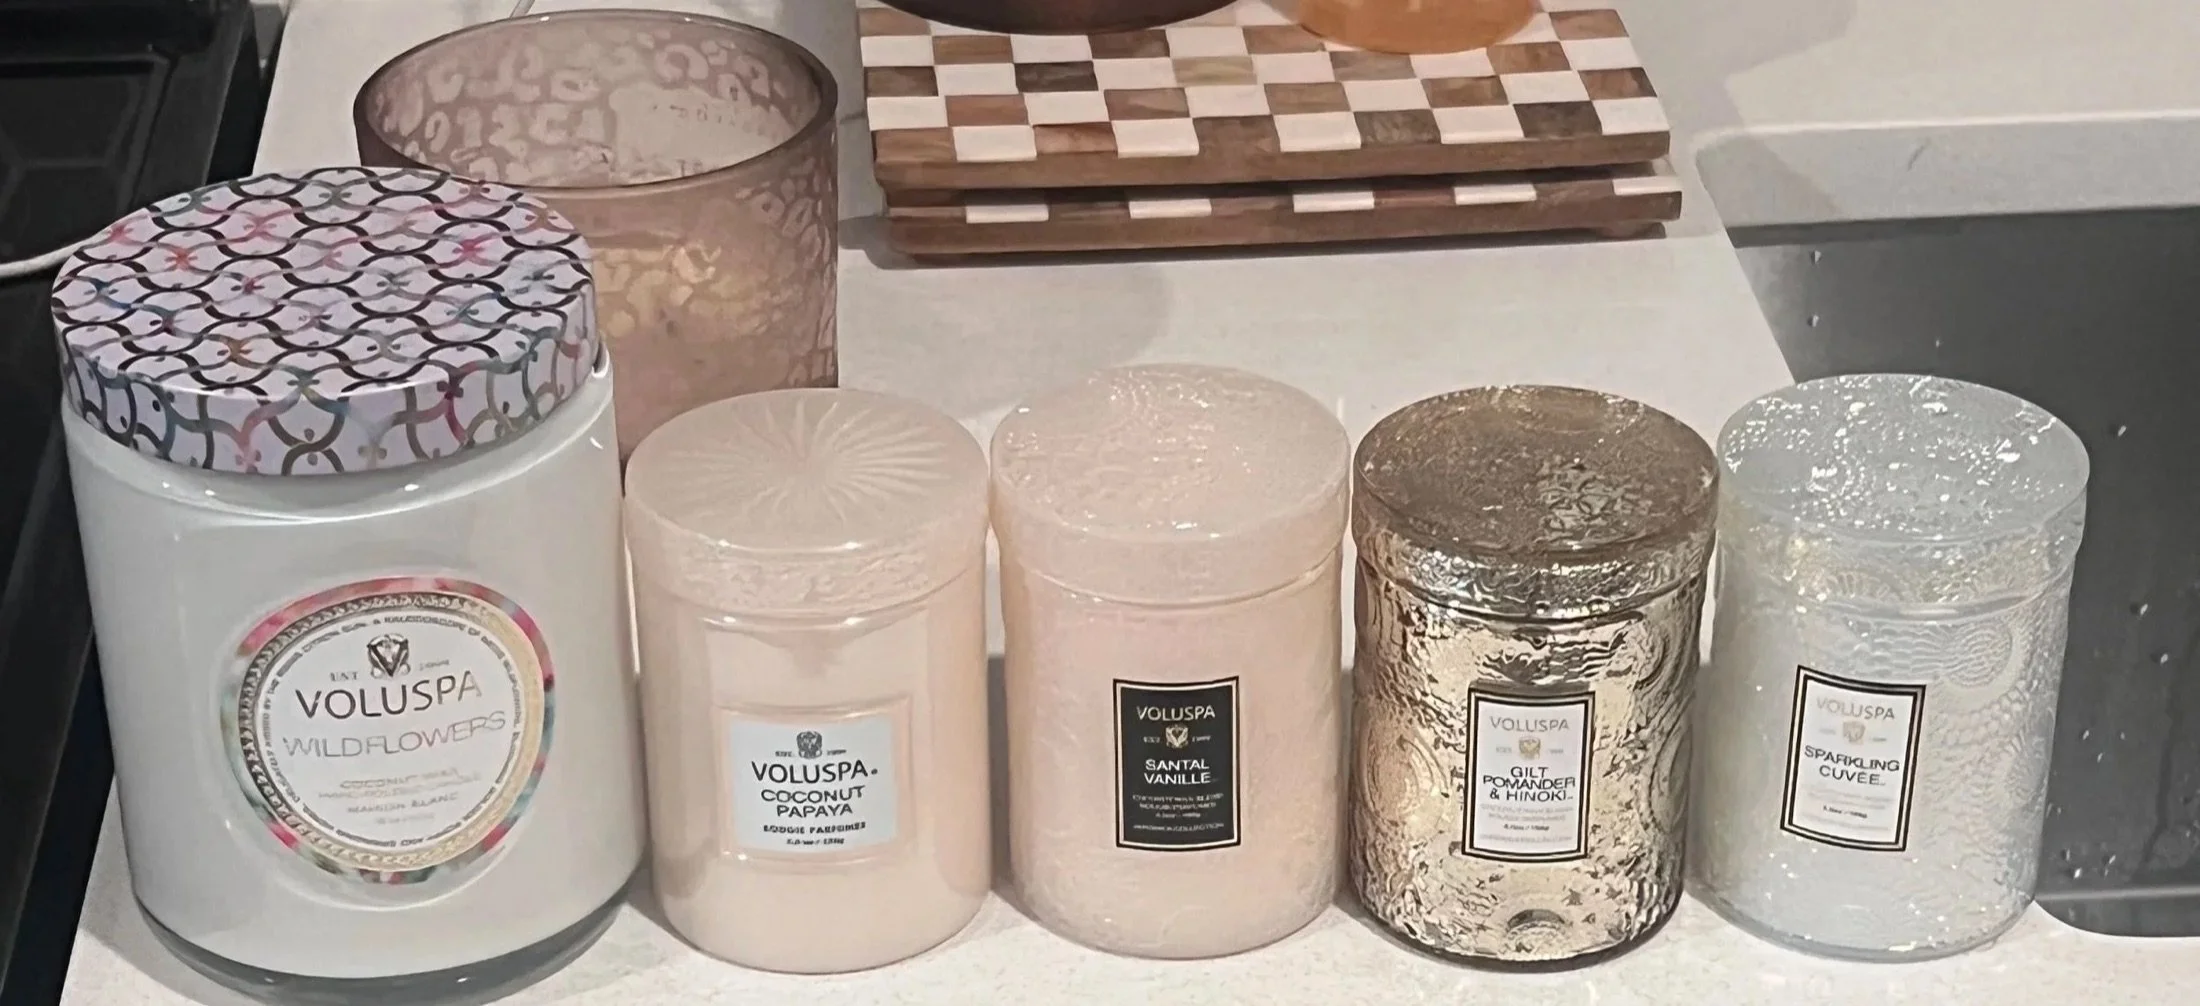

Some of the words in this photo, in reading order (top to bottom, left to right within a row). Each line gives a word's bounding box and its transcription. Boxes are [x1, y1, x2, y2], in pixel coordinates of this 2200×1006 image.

[295, 669, 482, 721] VOLUSPA
[1136, 705, 1216, 721] VOLUSPA
[1816, 697, 1896, 721] VOLUSPA
[1490, 715, 1570, 733] VOLUSPA
[282, 709, 506, 758] WILDFLOWERS
[1145, 759, 1210, 771] SANTAL
[1804, 745, 1901, 772] SPARKLING
[1143, 772, 1212, 785] VANILLE
[1510, 766, 1549, 779] GILT
[1482, 775, 1576, 791] POMANDER
[761, 785, 865, 804] COCONUT
[1489, 788, 1501, 801] &
[1506, 790, 1567, 802] HINOKI
[776, 803, 853, 818] PAPAYA
